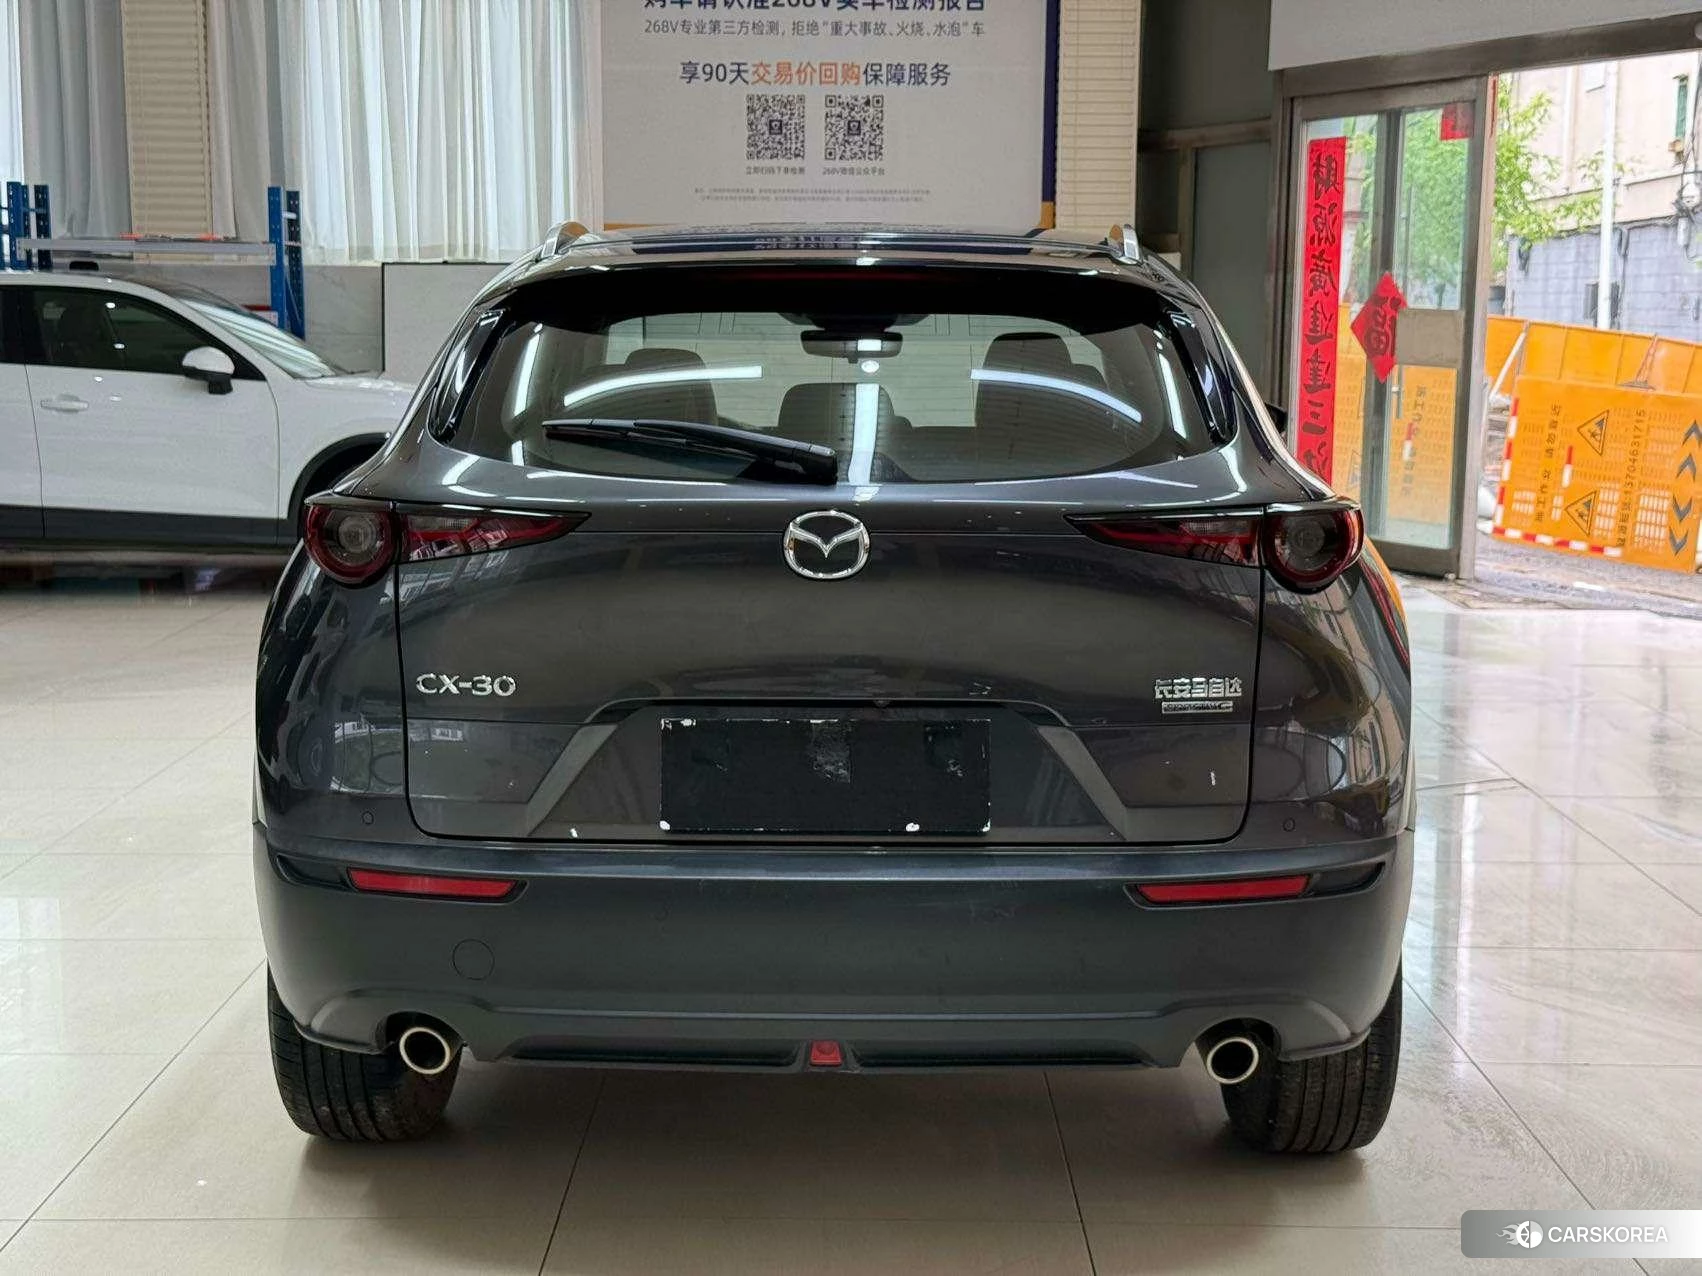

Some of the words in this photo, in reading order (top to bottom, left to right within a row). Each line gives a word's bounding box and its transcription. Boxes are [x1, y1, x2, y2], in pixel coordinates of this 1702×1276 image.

[679, 61, 952, 86] 享90天交易价回购保障服务
[416, 673, 516, 696] CX-30
[1154, 677, 1242, 699] 长安马自达
